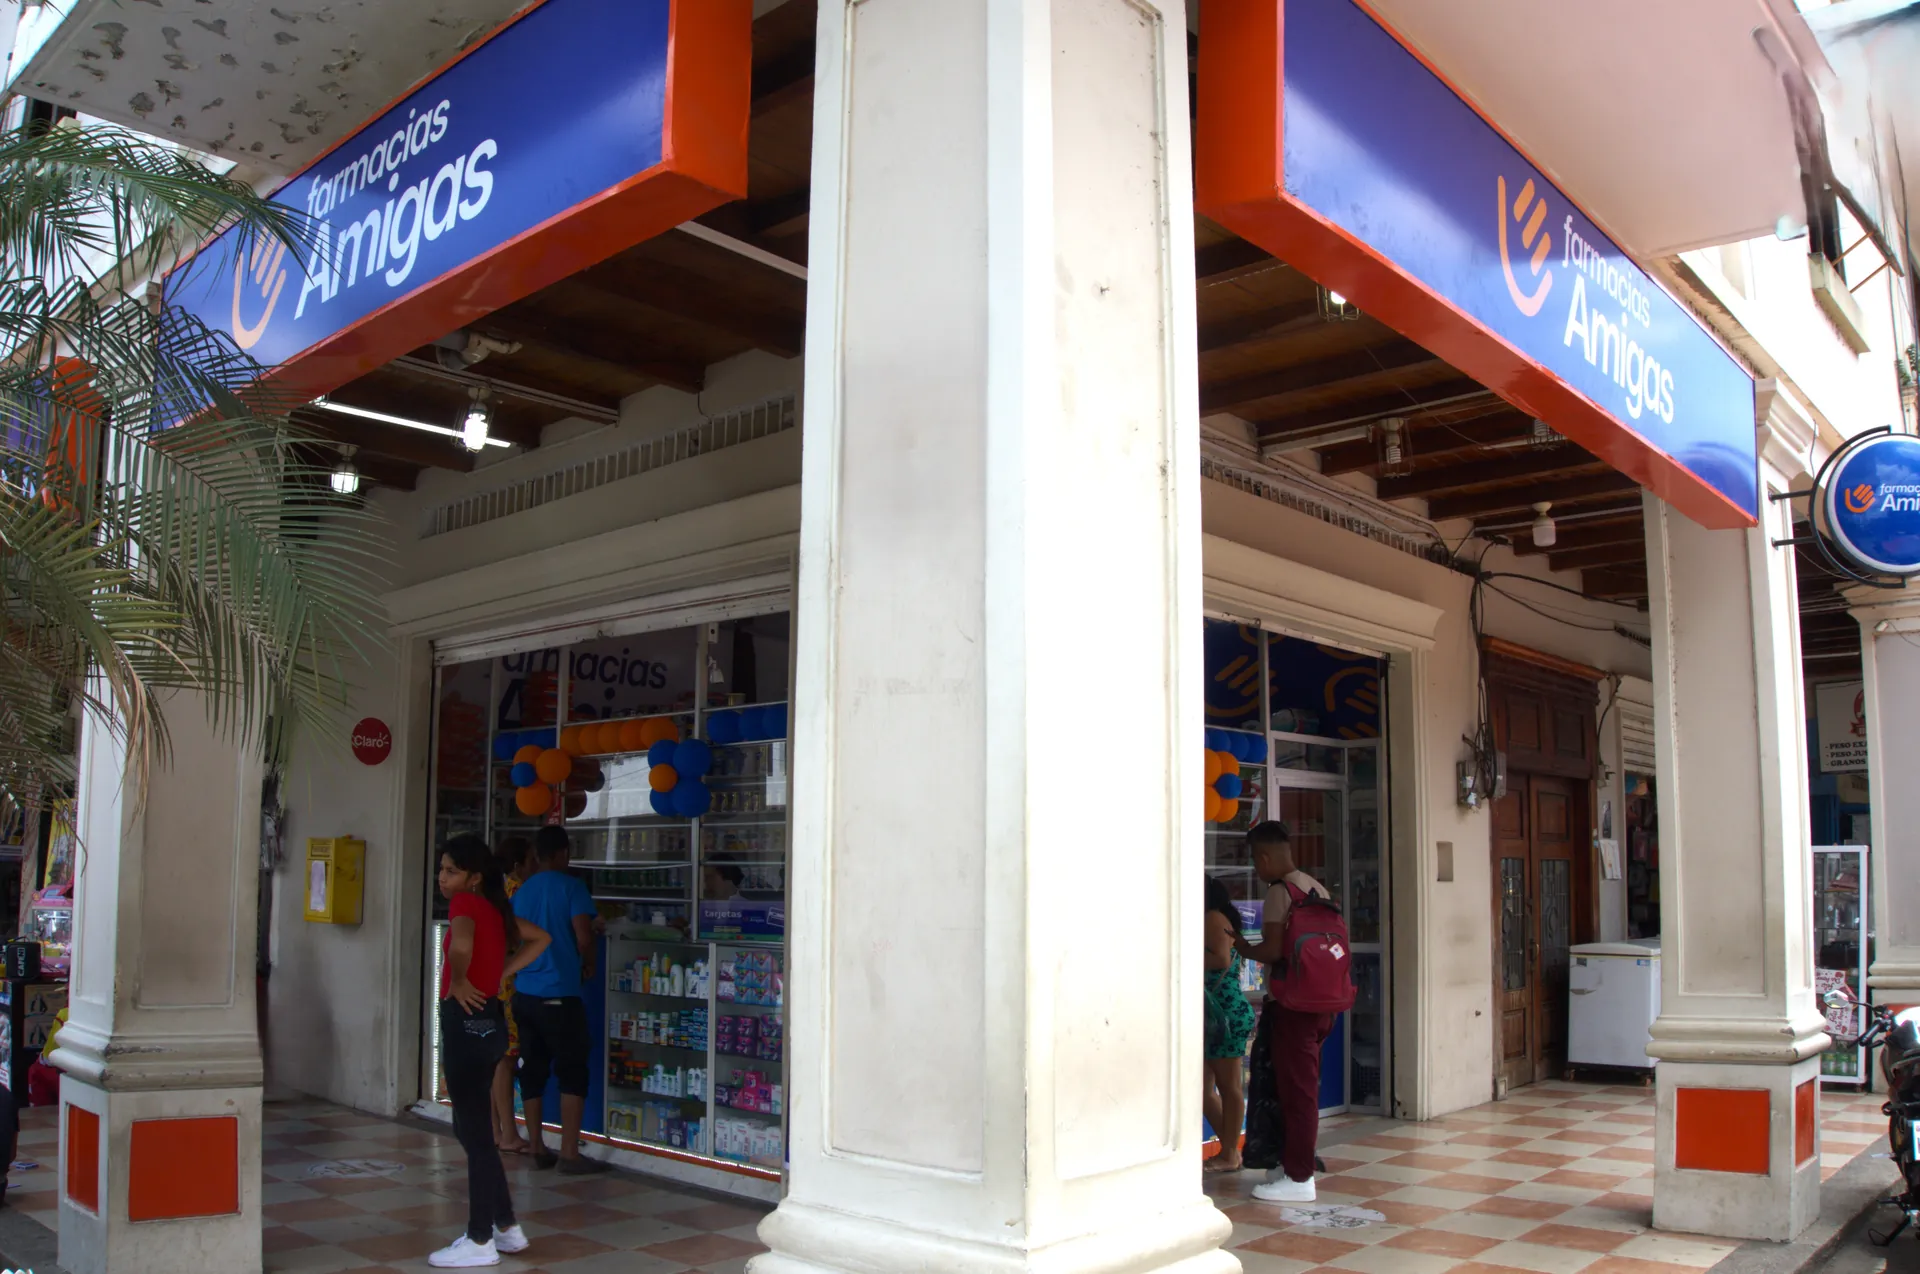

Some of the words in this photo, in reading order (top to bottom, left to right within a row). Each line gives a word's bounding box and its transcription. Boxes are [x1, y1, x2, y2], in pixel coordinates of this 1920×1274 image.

[294, 138, 498, 321] Amigas
[301, 99, 450, 243] farmacias
[1562, 215, 1649, 329] farmacias
[1563, 274, 1674, 424] Amigas
[353, 734, 384, 748] Claro
[704, 910, 743, 919] tarjetas
